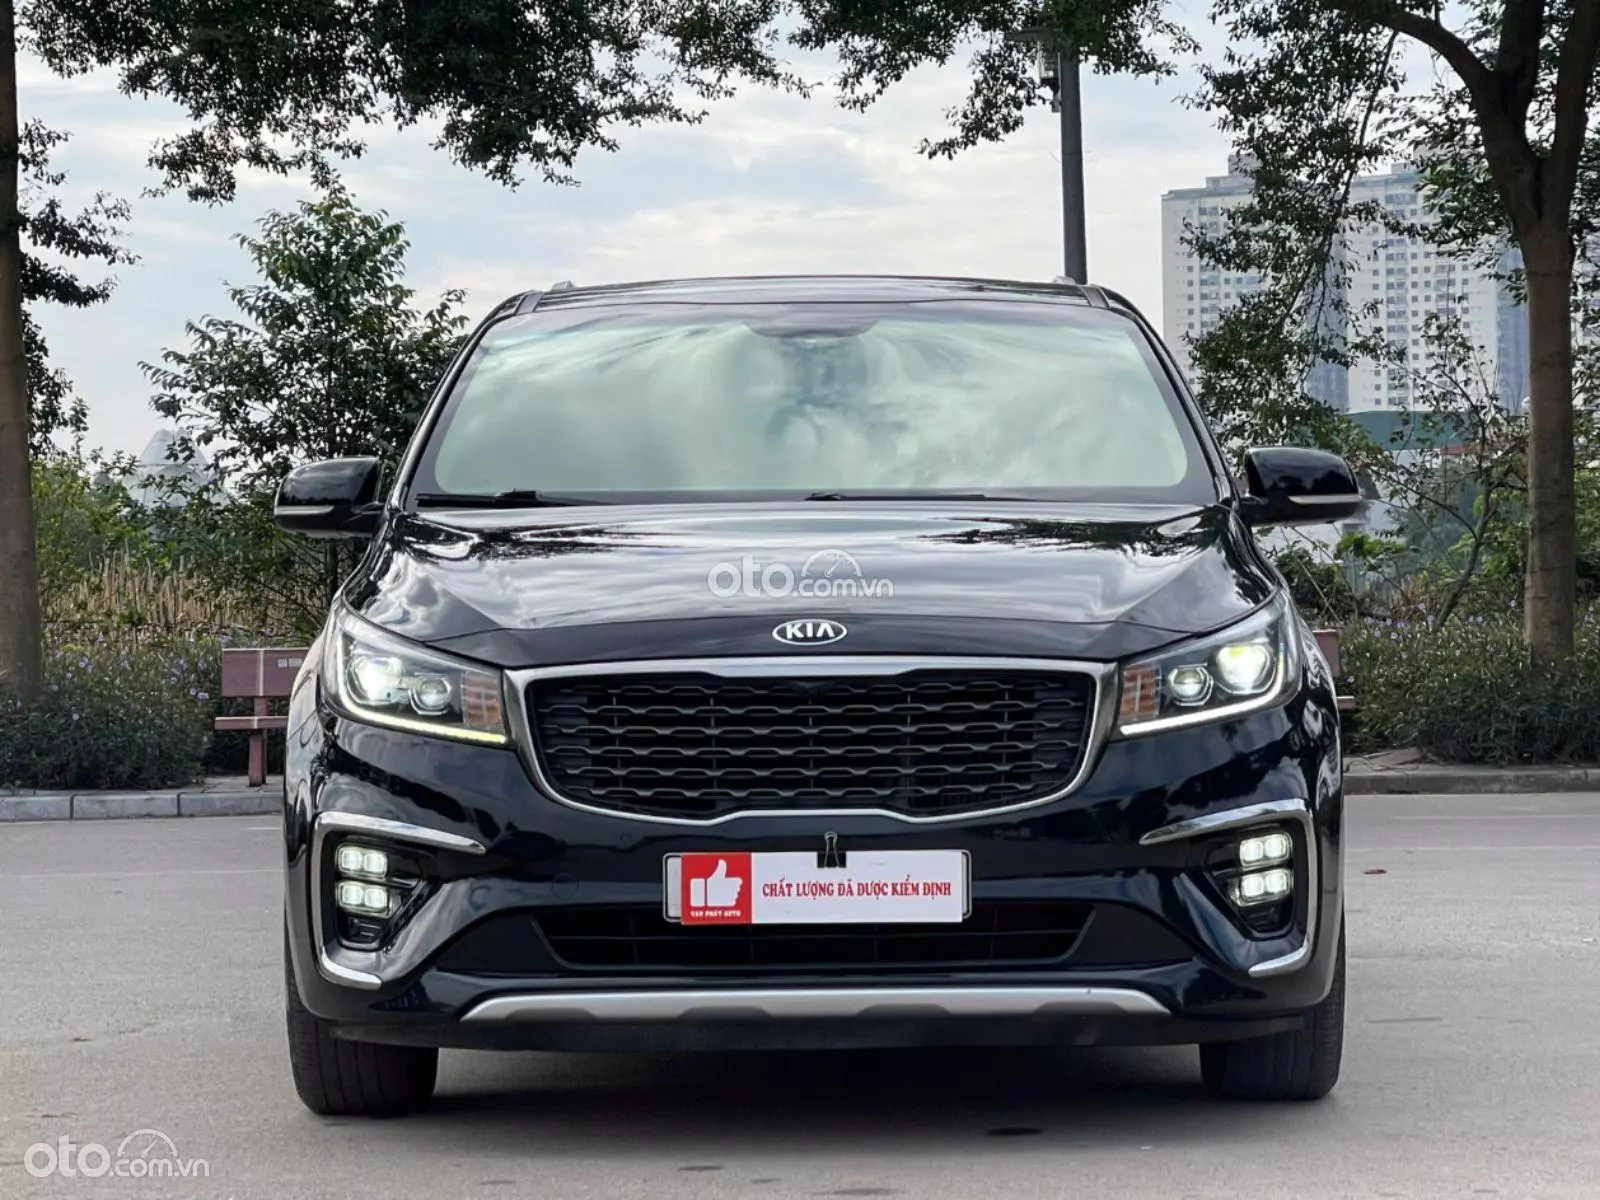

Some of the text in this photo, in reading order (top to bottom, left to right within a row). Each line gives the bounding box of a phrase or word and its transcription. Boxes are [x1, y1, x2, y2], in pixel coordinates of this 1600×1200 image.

[785, 622, 835, 640] KIA
[762, 876, 793, 897] CHẤT
[795, 880, 834, 900] LƯỢNG
[857, 880, 889, 900] ĐƯỢC
[891, 874, 919, 896] KIỂM
[922, 881, 951, 900] ĐỊNH
